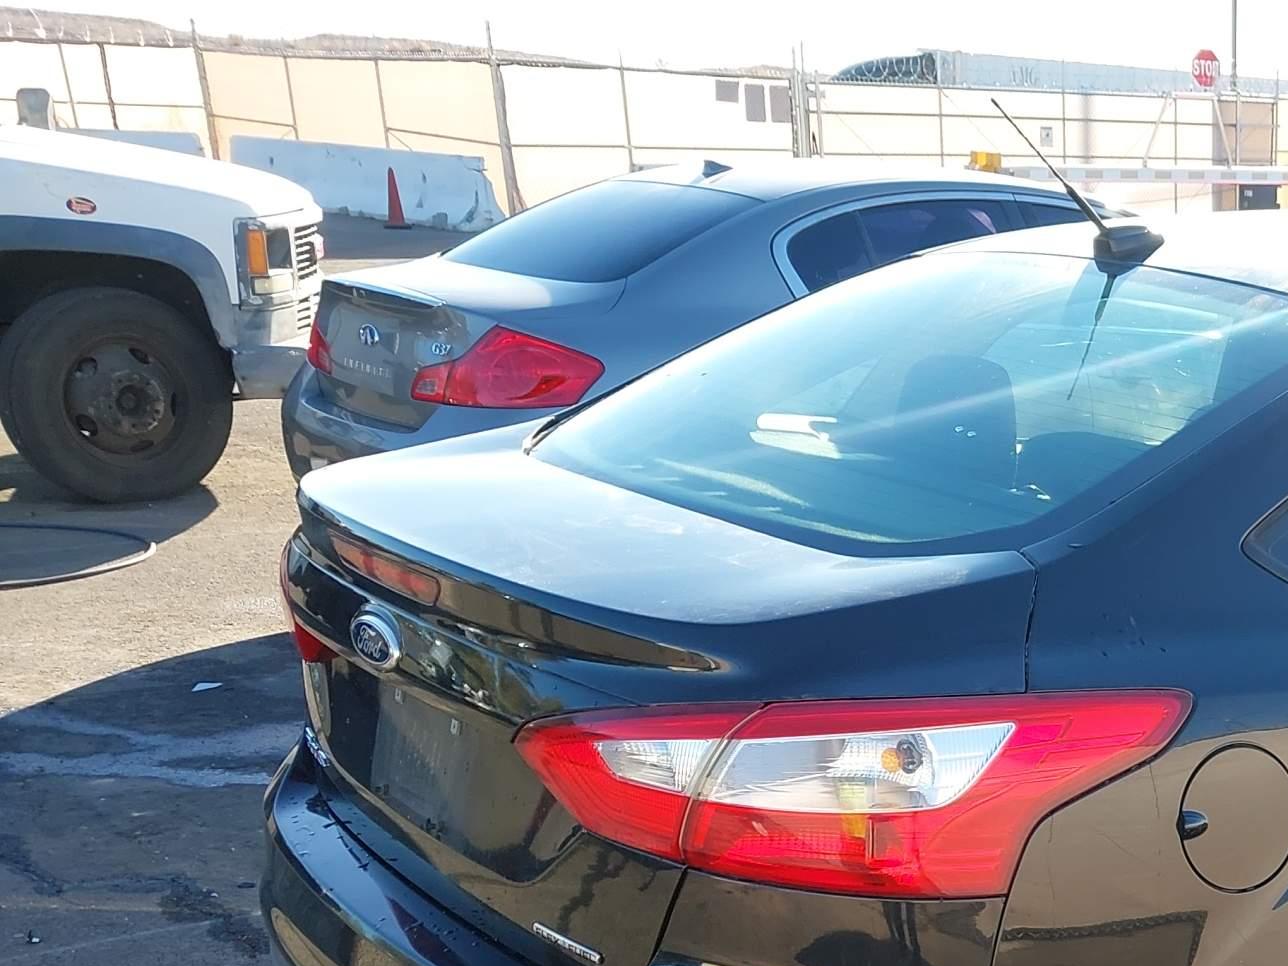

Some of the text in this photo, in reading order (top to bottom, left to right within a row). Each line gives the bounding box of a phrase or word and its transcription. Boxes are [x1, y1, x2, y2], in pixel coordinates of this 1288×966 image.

[1193, 59, 1219, 76] STOP
[432, 342, 451, 355] G37
[357, 625, 382, 659] Ford
